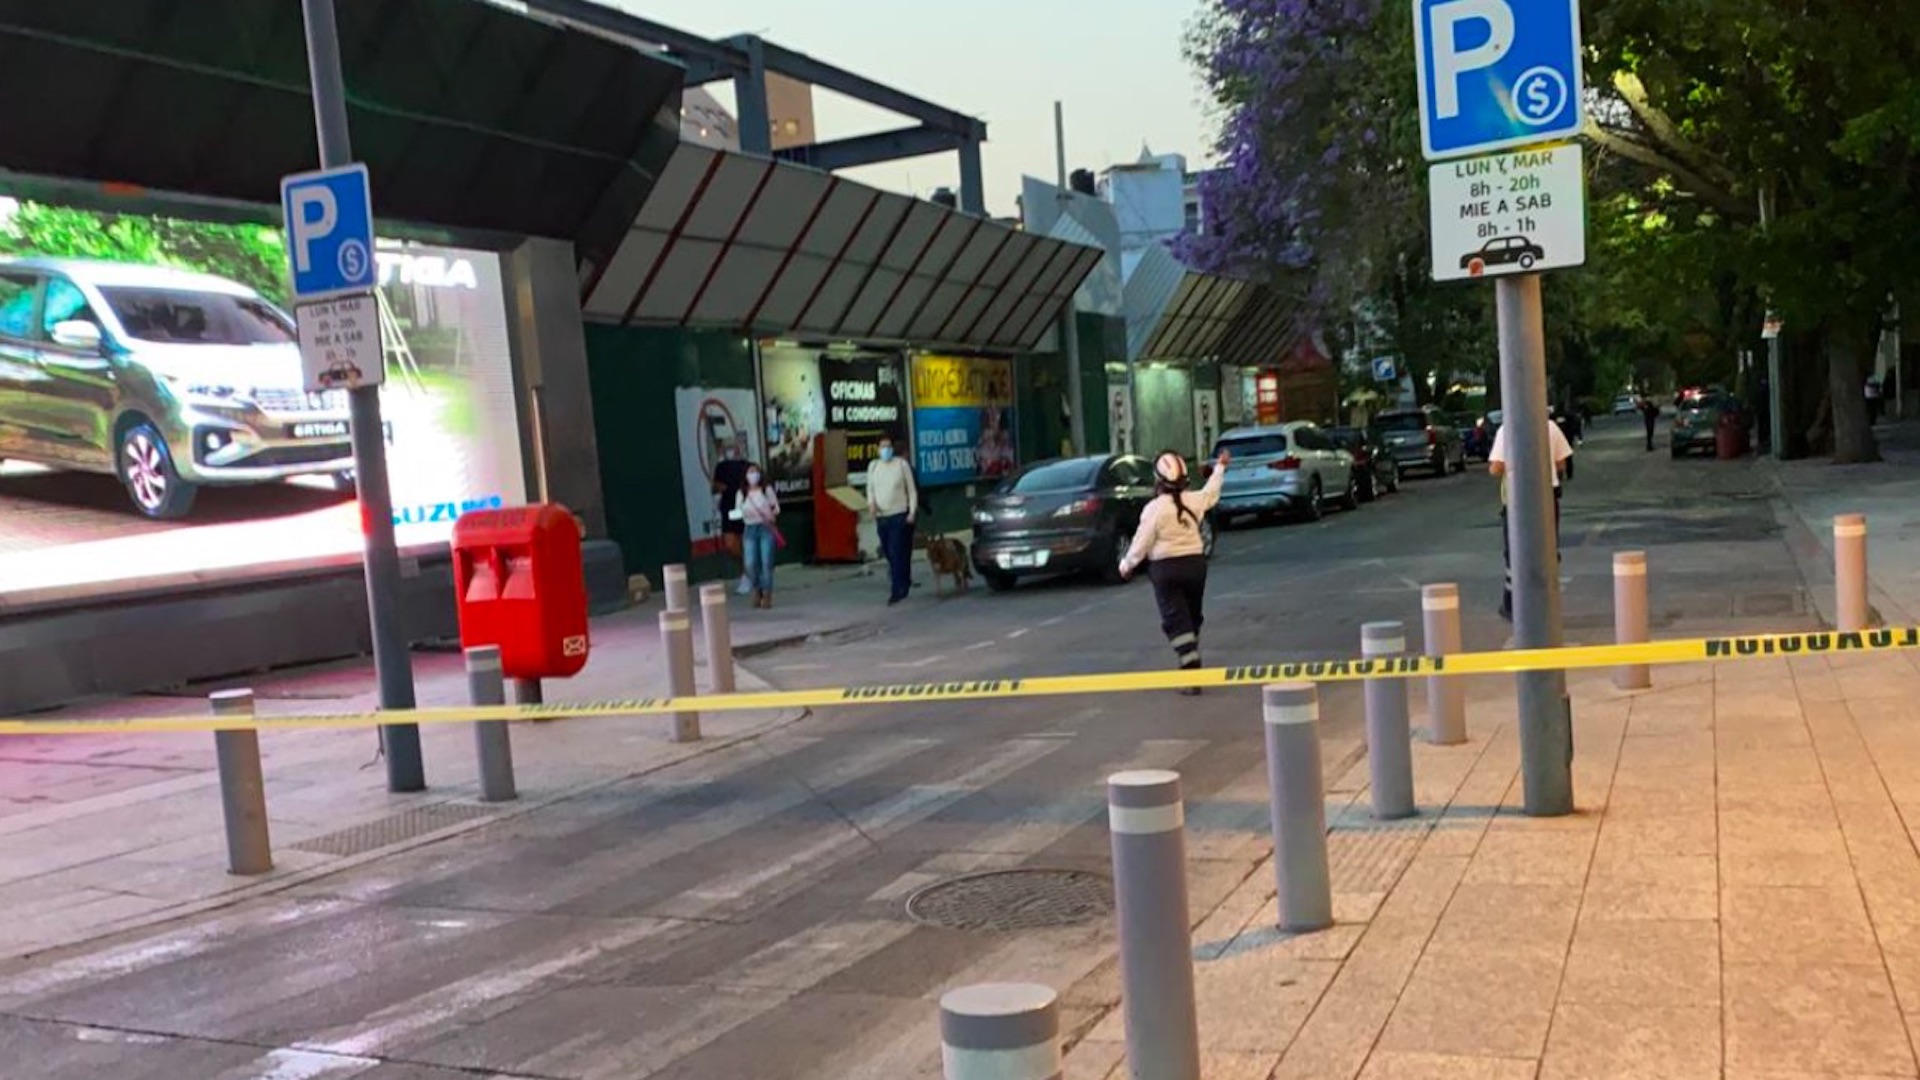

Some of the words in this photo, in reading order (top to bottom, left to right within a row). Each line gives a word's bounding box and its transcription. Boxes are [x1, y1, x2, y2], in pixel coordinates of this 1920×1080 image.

[1430, 0, 1515, 119] P
[1456, 157, 1491, 178] LUN
[1513, 151, 1553, 168] MAR
[1470, 182, 1490, 198] 8h
[1509, 174, 1540, 192] 20h
[1459, 201, 1497, 219] MIE
[1497, 199, 1509, 214] A
[1516, 193, 1552, 211] SAB
[290, 185, 338, 272] P
[1477, 220, 1498, 238] 8h
[1518, 215, 1536, 234] 1h
[374, 252, 477, 288] TIGA
[830, 380, 876, 400] OFICINAS
[831, 406, 845, 423] EN
